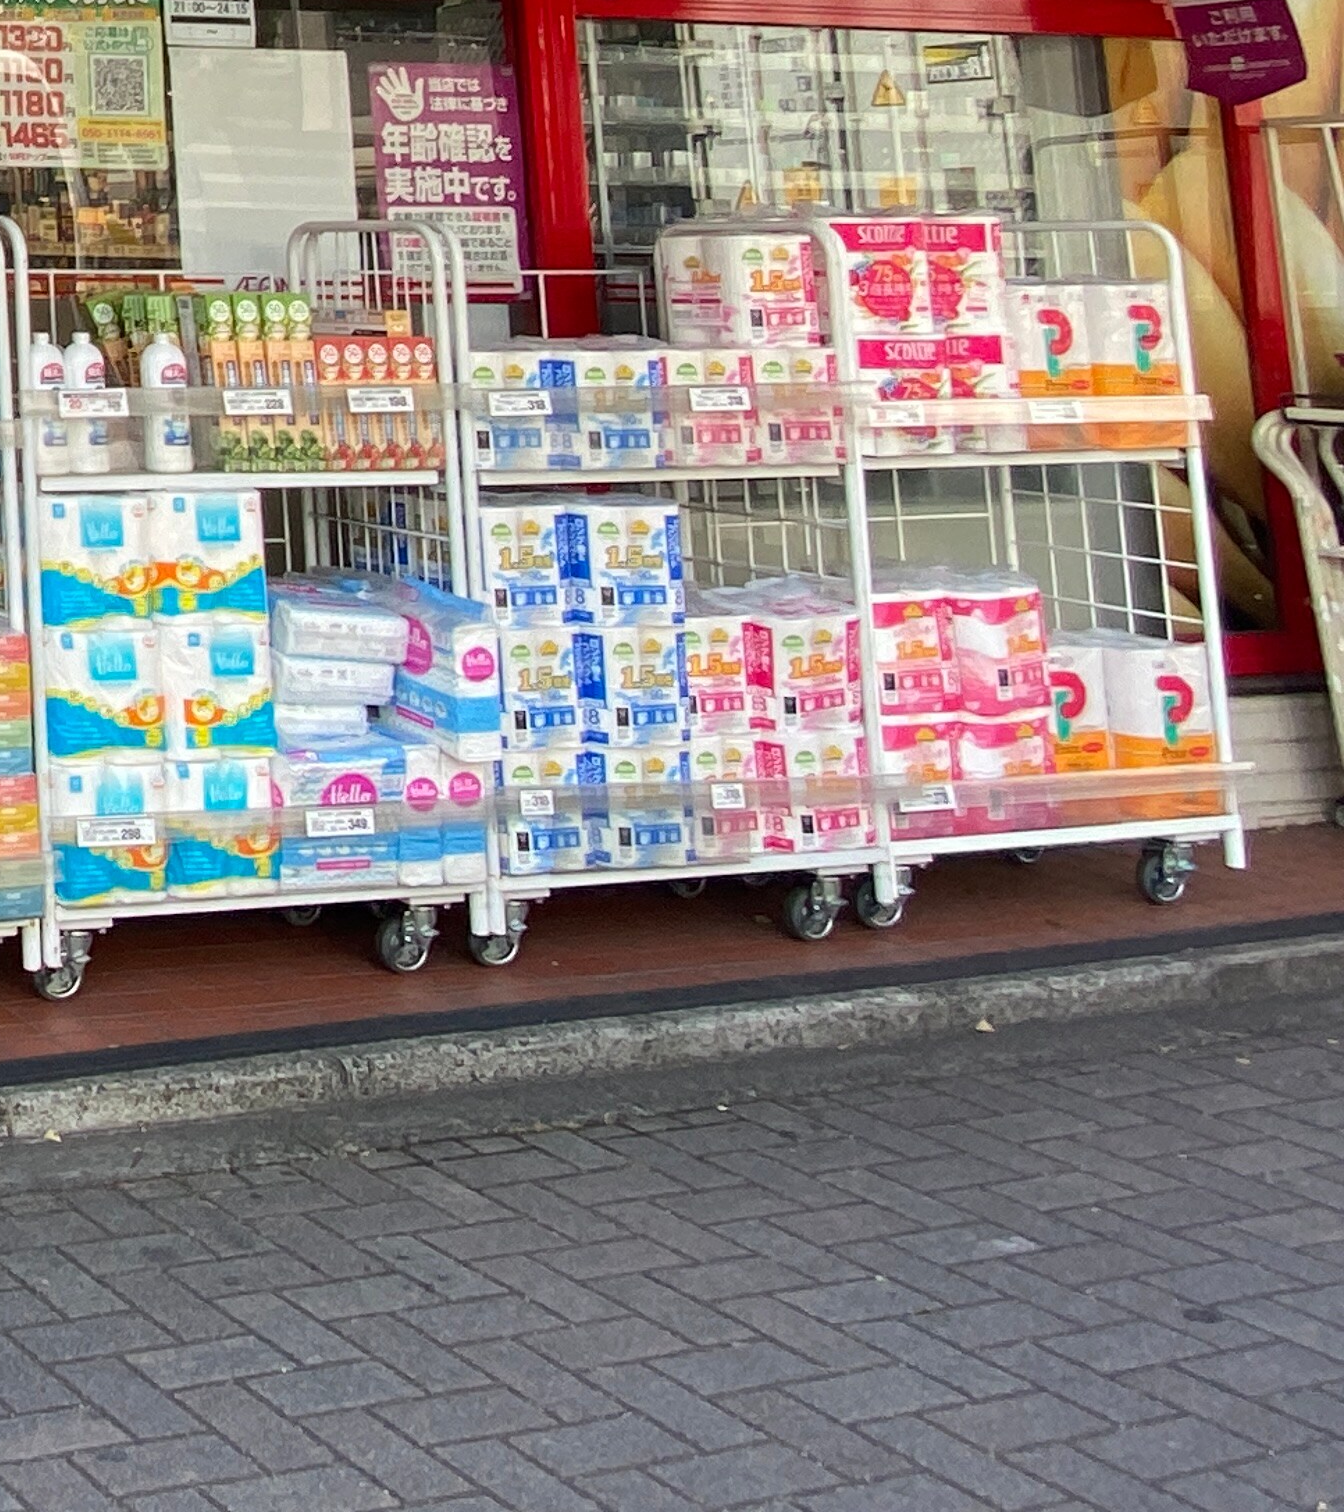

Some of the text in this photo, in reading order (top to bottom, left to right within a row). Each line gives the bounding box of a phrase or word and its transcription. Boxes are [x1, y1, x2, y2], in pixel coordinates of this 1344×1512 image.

[381, 121, 513, 164] 年齢確認を
[384, 166, 518, 204] 実施中です。
[329, 780, 373, 804] Hello
